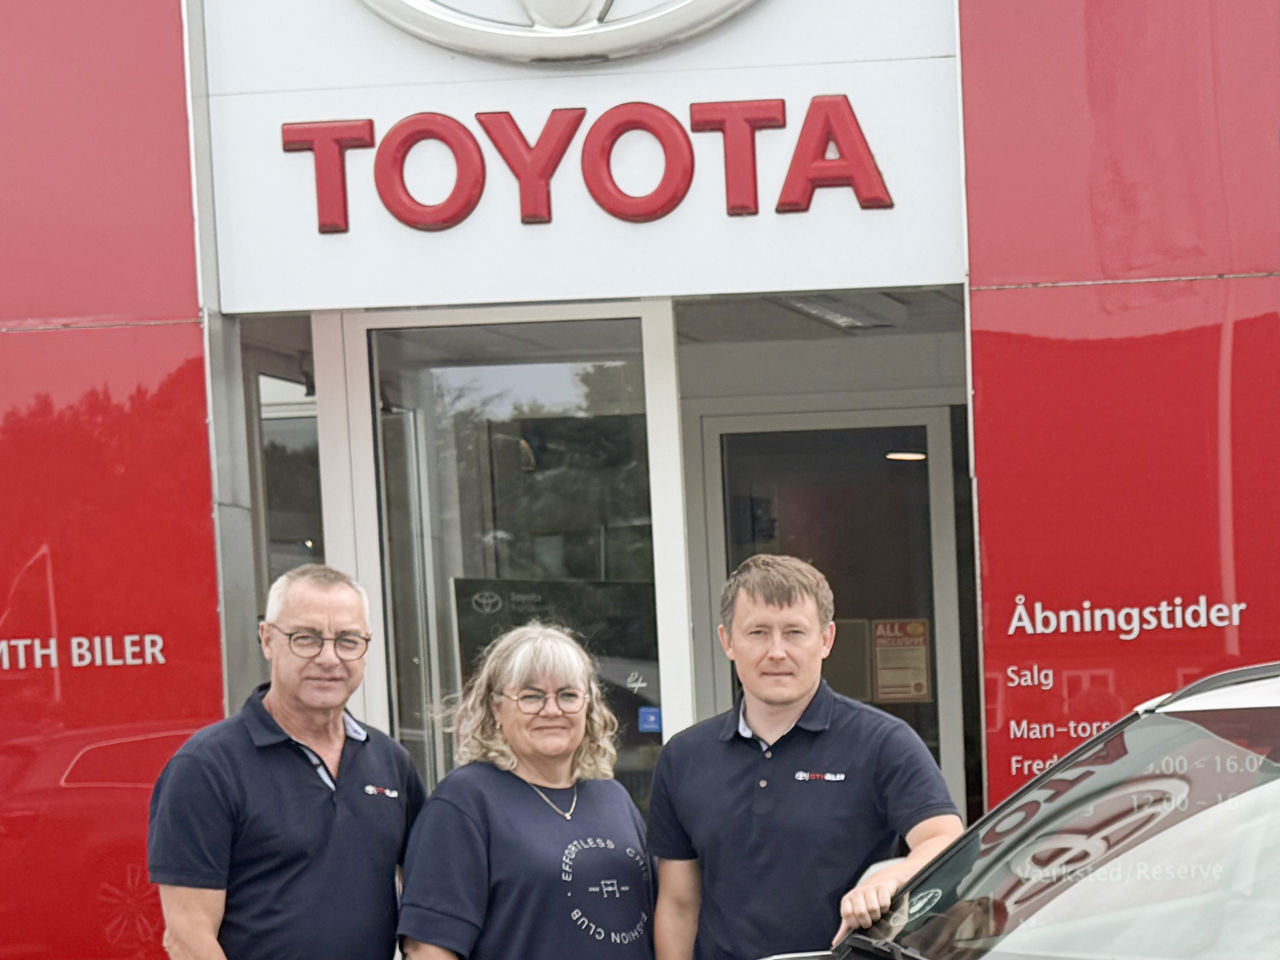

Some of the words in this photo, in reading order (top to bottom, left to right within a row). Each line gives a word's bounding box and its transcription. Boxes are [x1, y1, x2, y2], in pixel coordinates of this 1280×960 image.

[281, 94, 894, 234] TOYOTA
[1007, 594, 1247, 640] Åbningstider
[70, 634, 166, 666] BILER
[1006, 664, 1054, 690] Salg
[571, 908, 605, 940] CLUB
